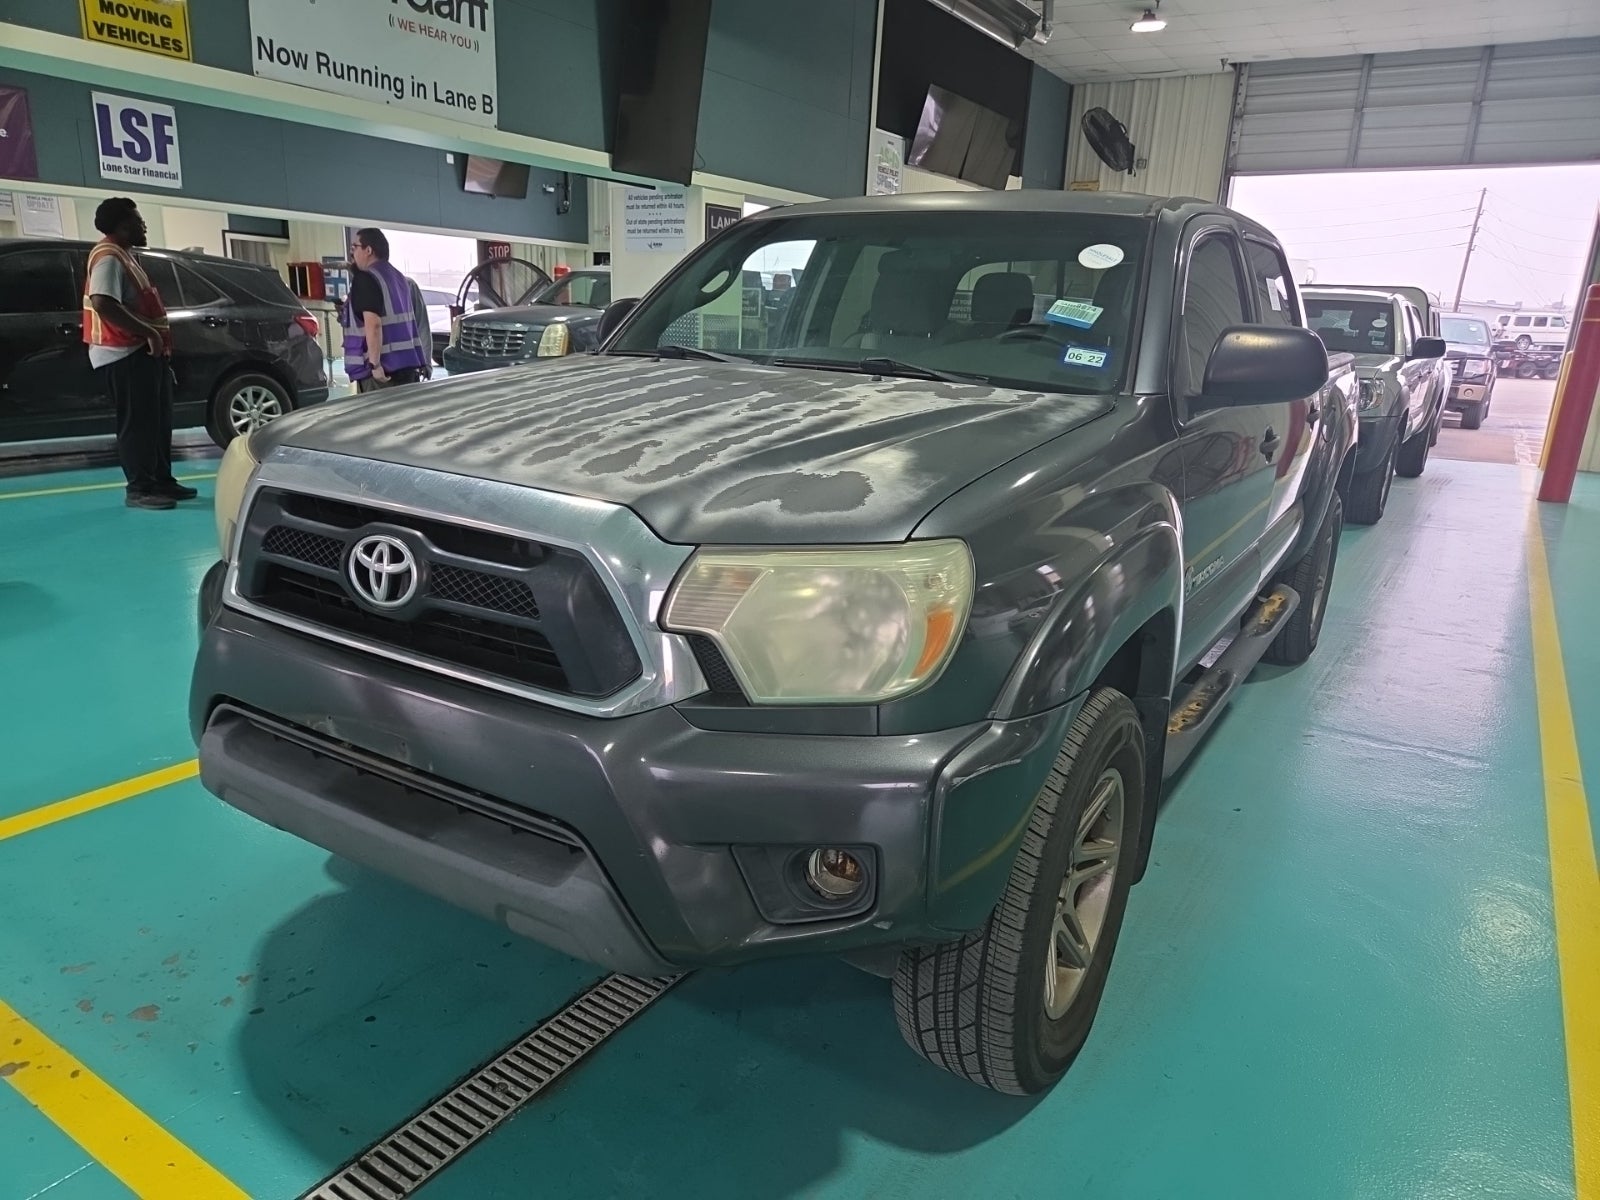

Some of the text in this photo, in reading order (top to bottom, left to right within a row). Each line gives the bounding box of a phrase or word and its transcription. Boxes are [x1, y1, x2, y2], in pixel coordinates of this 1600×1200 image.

[99, 0, 173, 28] MOVING
[93, 20, 183, 53] VEHICLES
[397, 17, 471, 49] WE HEAR YOU
[257, 36, 494, 115] Now Running in Lane B
[96, 103, 174, 165] LSF
[102, 161, 179, 181] Lone Star Financial
[27, 200, 54, 209] UPDATE
[488, 245, 510, 259] STOP
[1068, 352, 1103, 364] 06 22
